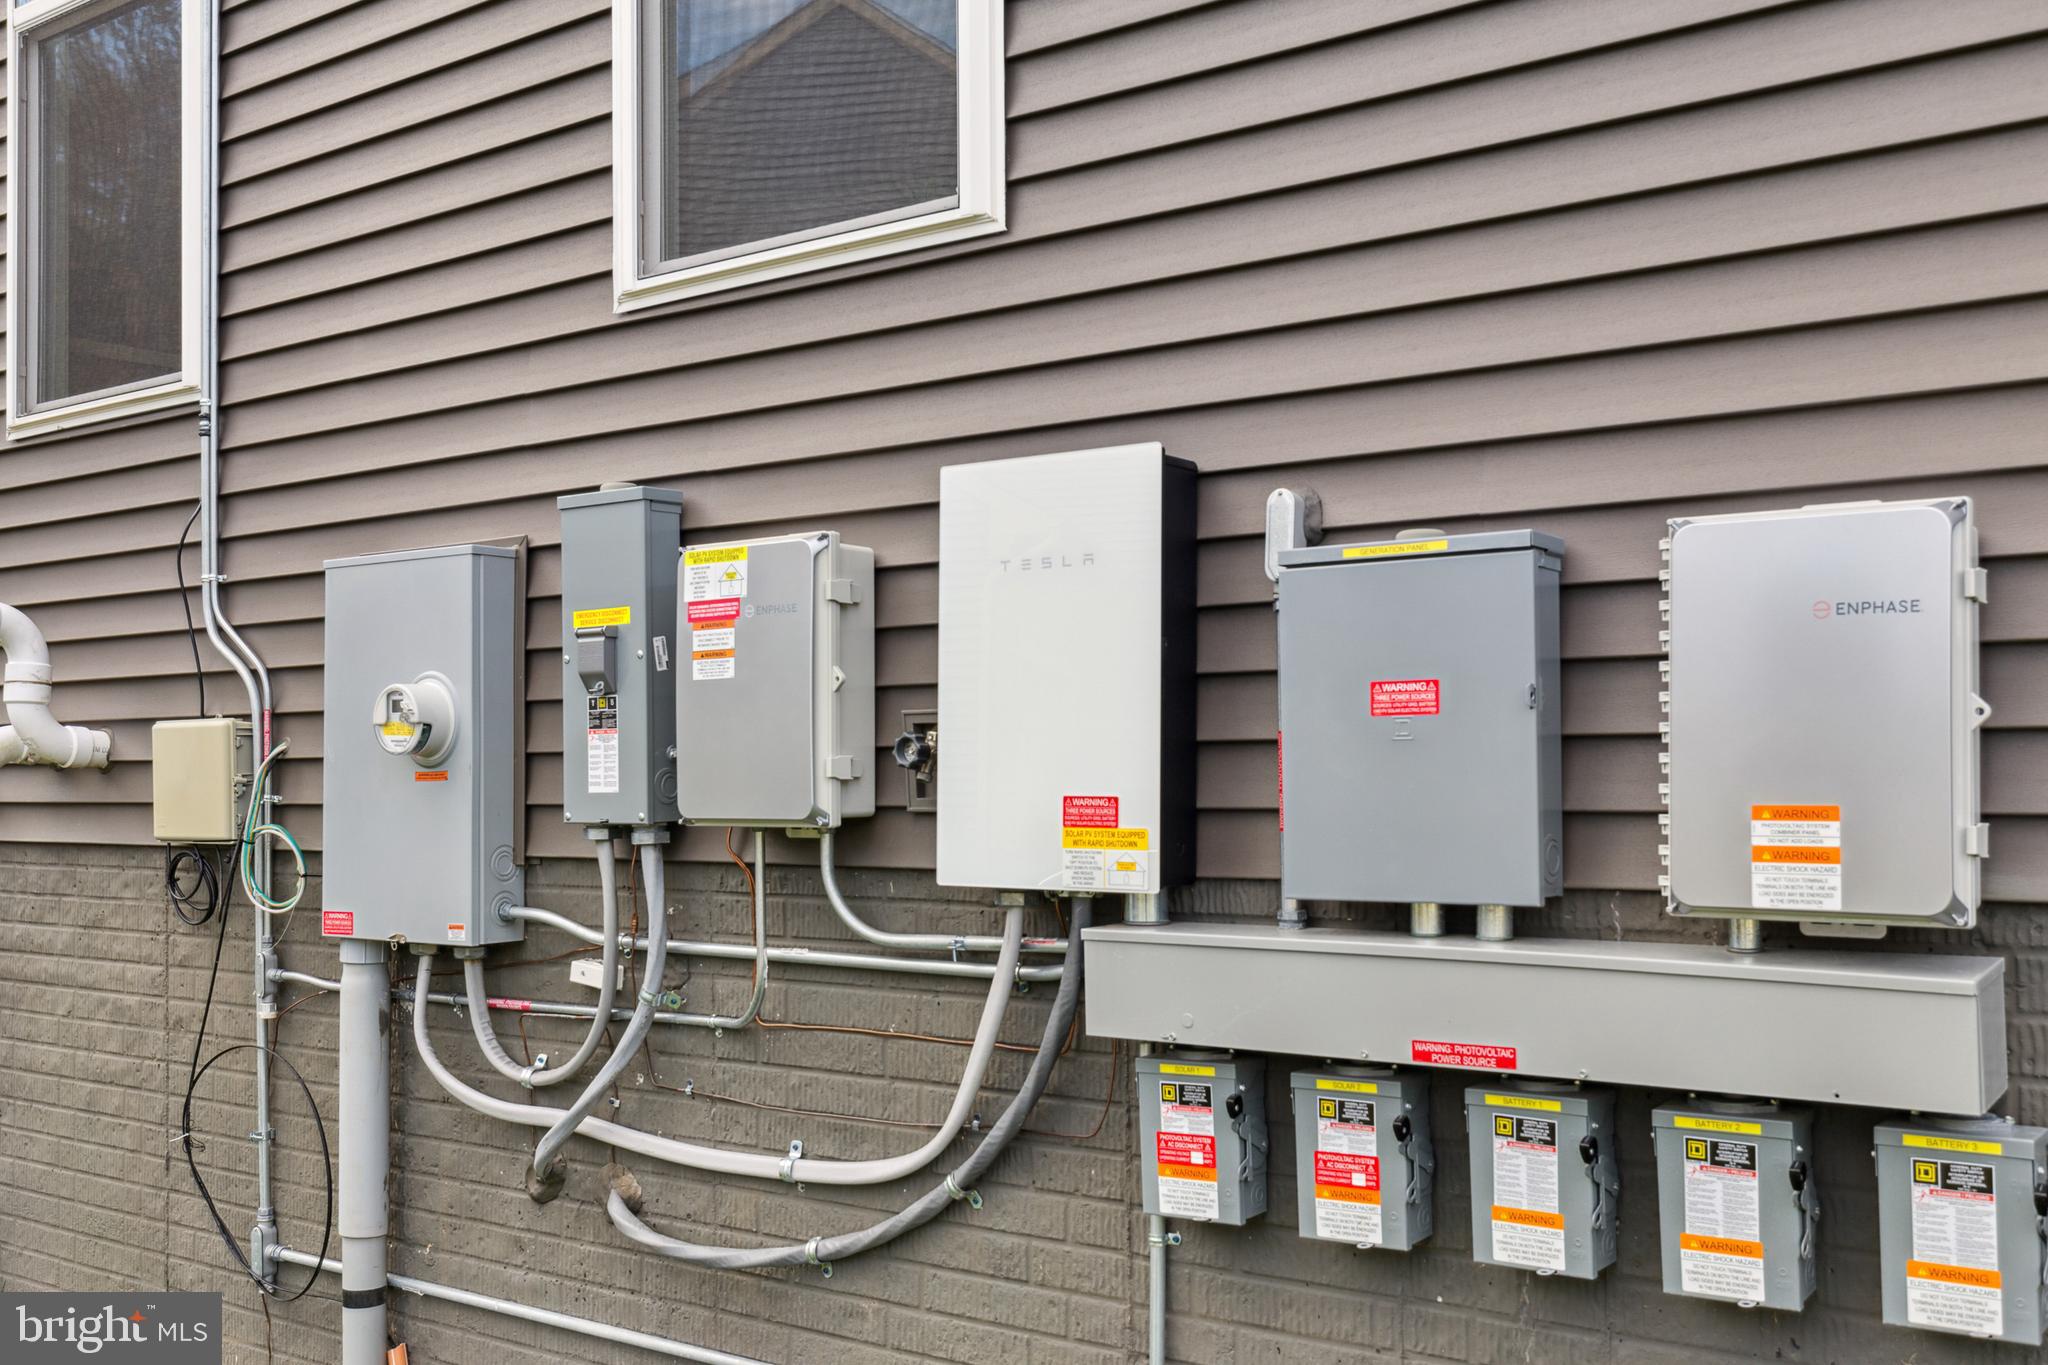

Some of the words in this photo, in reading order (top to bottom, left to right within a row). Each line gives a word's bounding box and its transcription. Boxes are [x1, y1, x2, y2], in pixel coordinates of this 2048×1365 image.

[1360, 546, 1405, 555] GENERATION
[1000, 554, 1094, 572] TESLA
[756, 603, 800, 616] ENPHASE
[1836, 599, 1920, 616] ENPHASE
[1382, 682, 1426, 691] WARNING
[1072, 798, 1108, 806] WARNING
[1773, 809, 1830, 818] WARNING
[1773, 850, 1830, 860] WARNING
[1414, 1042, 1453, 1053] WARNING:
[1454, 1046, 1514, 1058] PHOTOVOLTAIC
[1432, 1054, 1462, 1064] POWER
[1462, 1056, 1496, 1068] SOURCE
[1503, 1097, 1536, 1107] BATTERY
[1695, 1119, 1732, 1129] BATTERY
[1926, 1138, 1969, 1149] BATTERY
[1318, 1154, 1354, 1162] PHOTOVOLTAIC
[1334, 1162, 1366, 1171] DISCONNECT
[1169, 1168, 1209, 1178] WARNING
[1330, 1190, 1372, 1201] WARNING
[1509, 1212, 1555, 1226] WARNING
[1494, 1223, 1519, 1231] ELECTRIC
[1520, 1226, 1539, 1234] SHOCK
[1540, 1229, 1562, 1237] HAZARD
[1697, 1240, 1752, 1254] WARNING
[1684, 1252, 1711, 1261] ELECTRIC
[1713, 1255, 1733, 1263] SHOCK
[1735, 1258, 1760, 1267] HAZARD
[1928, 1268, 1989, 1284] WARNING
[1910, 1280, 1943, 1289] ELECTRIC
[1944, 1284, 1966, 1292] SHOCK
[1968, 1287, 1998, 1297] HAZARD
